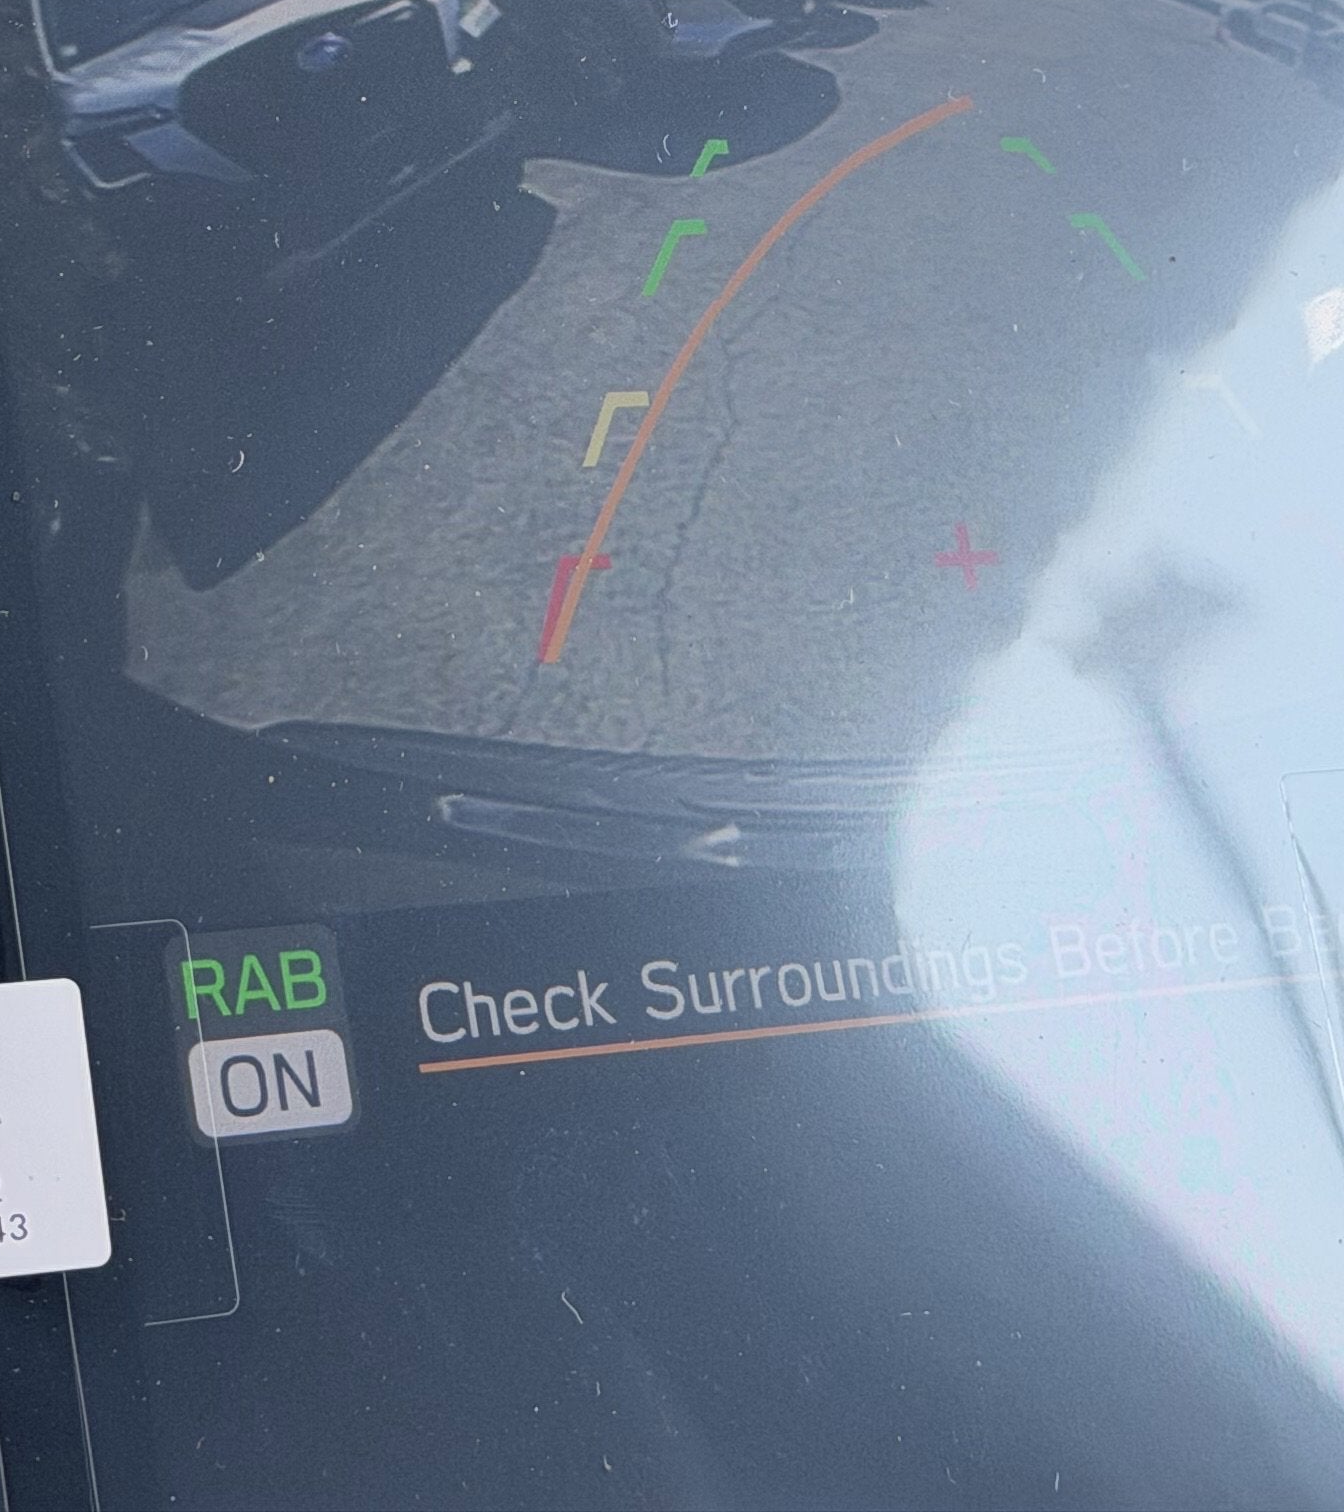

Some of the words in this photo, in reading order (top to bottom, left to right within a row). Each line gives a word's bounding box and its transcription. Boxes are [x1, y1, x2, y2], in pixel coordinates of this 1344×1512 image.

[181, 948, 327, 1021] RAB
[417, 969, 618, 1045] Check
[643, 934, 1030, 1022] Surroundings
[1055, 912, 1239, 981] Before
[218, 1050, 324, 1119] ON
